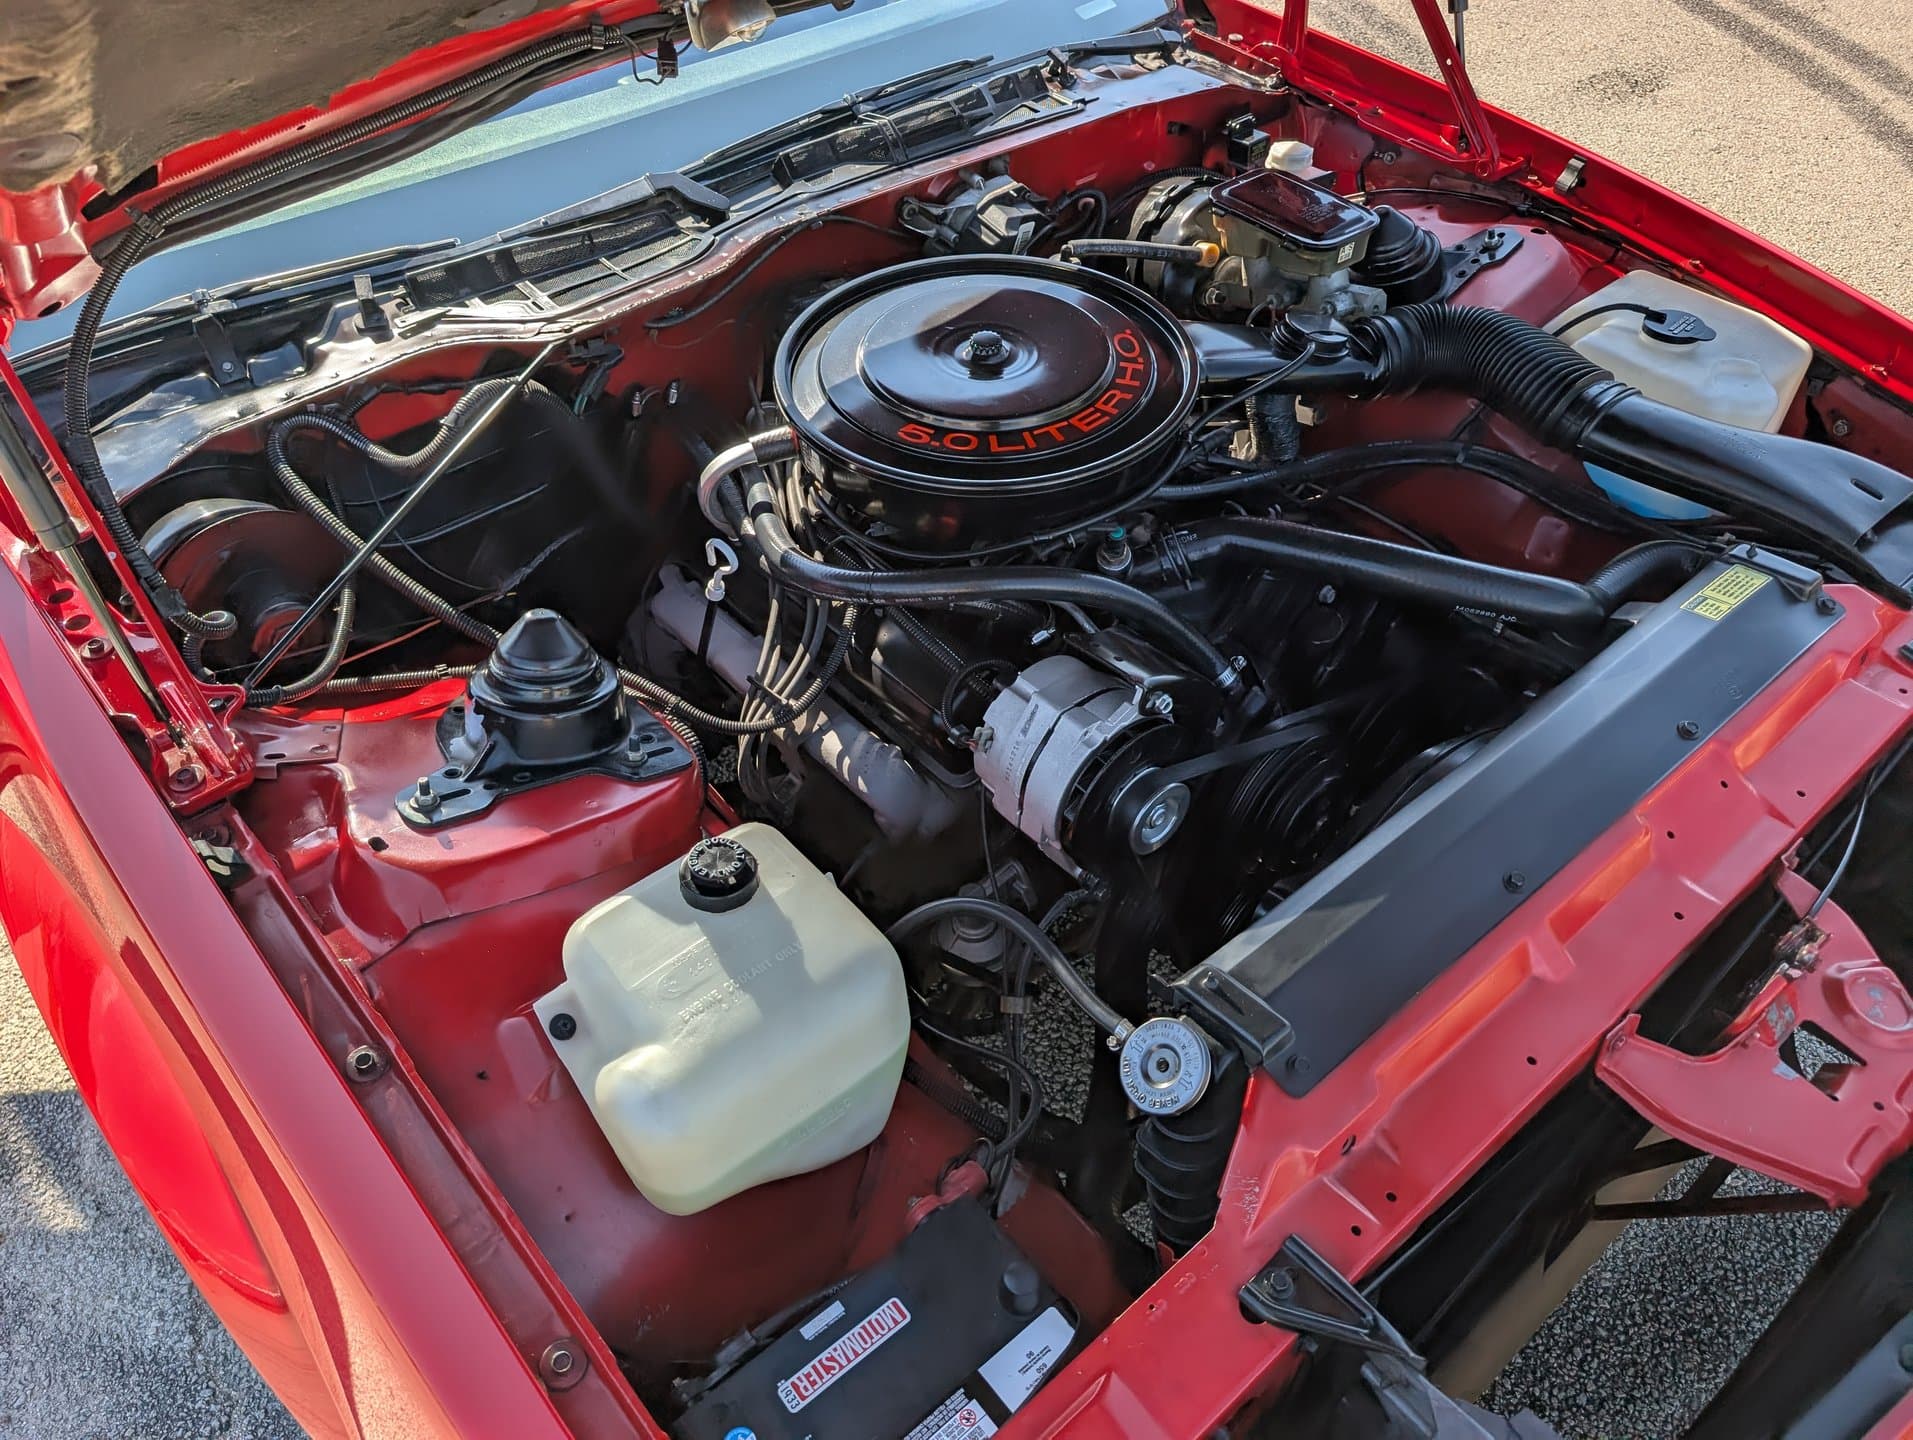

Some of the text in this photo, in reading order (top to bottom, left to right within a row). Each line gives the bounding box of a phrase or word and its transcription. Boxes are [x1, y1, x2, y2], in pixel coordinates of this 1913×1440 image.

[898, 423, 977, 450] 5.0
[989, 389, 1133, 453] LITER
[688, 837, 744, 878] ENGINE COOLANT ONLY
[792, 1302, 903, 1397] MOTOMASTER
[778, 1385, 801, 1410] 1933
